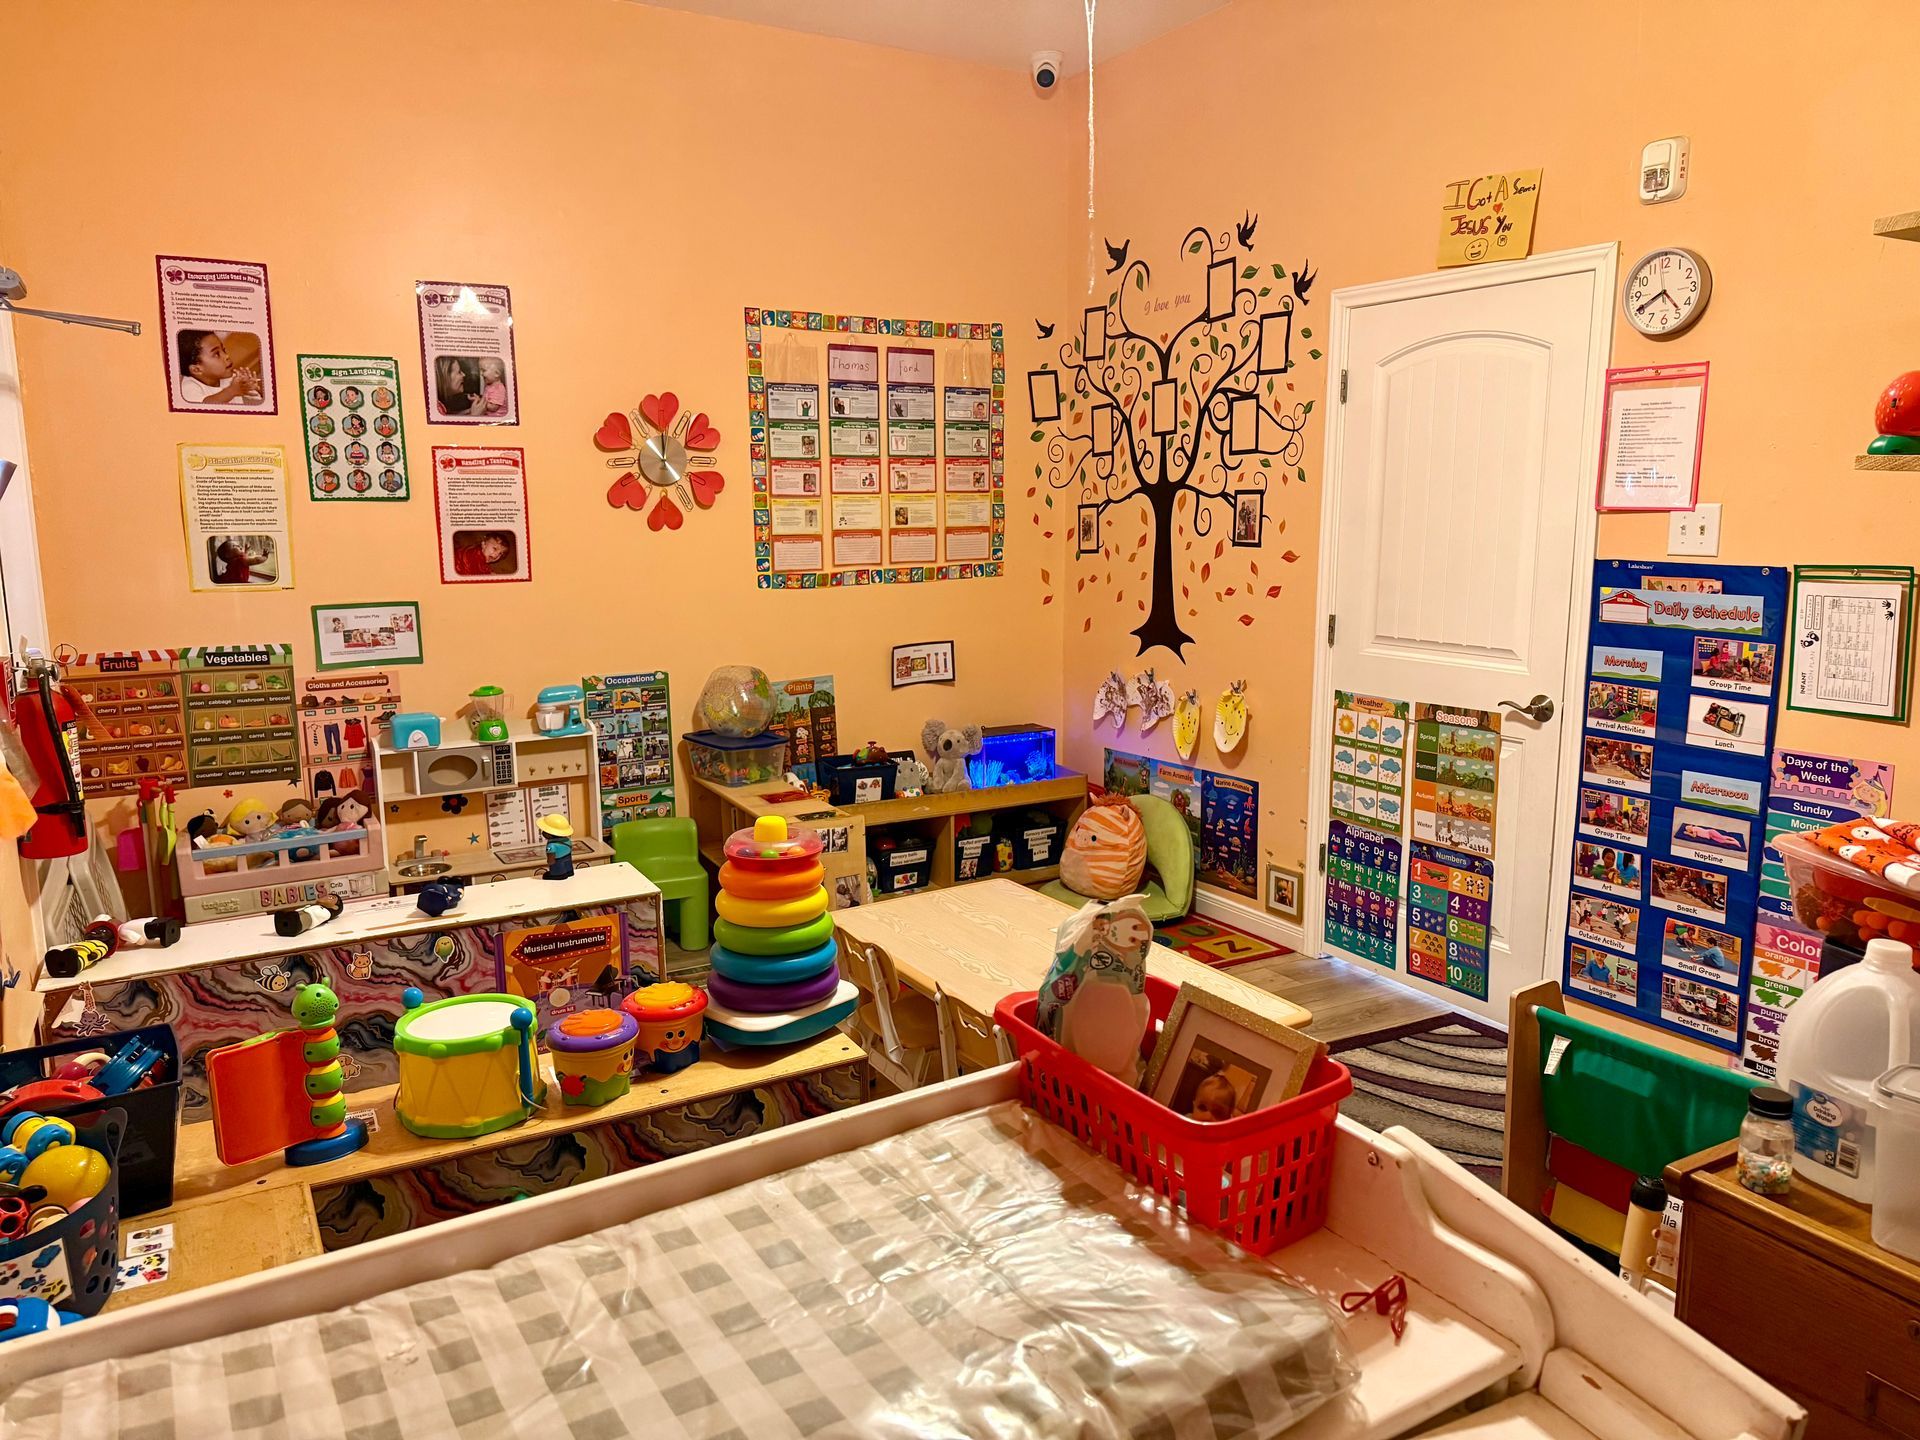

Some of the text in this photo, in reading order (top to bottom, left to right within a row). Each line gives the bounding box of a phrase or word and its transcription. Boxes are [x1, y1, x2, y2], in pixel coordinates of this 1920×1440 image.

[1443, 175, 1509, 210] I Got A
[1450, 214, 1513, 236] Jesus You
[1649, 263, 1656, 276] 11
[1661, 257, 1671, 269] 12
[1638, 267, 1693, 288] 10 2
[1634, 280, 1697, 302] 9 3
[1154, 297, 1169, 312] love
[1174, 294, 1191, 308] you
[1683, 296, 1691, 306] 4
[1648, 308, 1681, 325] 7 6 5
[832, 357, 870, 372] Thomas
[331, 369, 348, 377] Sign
[1654, 600, 1760, 623] Daily Schedule
[102, 659, 137, 670] Fruits
[205, 653, 268, 665] Vegetables
[1604, 655, 1648, 673] Morning
[331, 680, 345, 688] and
[345, 678, 387, 687] Accessories
[606, 675, 655, 686] Occupations
[788, 682, 813, 692] Plants
[1709, 679, 1751, 691] Group Time
[208, 698, 232, 706] cabbage
[1356, 697, 1383, 709] Weather
[97, 706, 117, 715] cherry
[124, 705, 142, 713] peach
[1436, 710, 1479, 728] Seasons
[1595, 720, 1646, 734] Arrival Activities
[155, 740, 182, 748] pineapple
[1420, 733, 1437, 743] Spring
[1714, 739, 1735, 749] Lunch
[1416, 762, 1437, 771] Summer
[1786, 756, 1849, 774] Days of the
[195, 771, 223, 779] cucumber
[1159, 769, 1193, 782] Farm Animals
[1607, 777, 1626, 786] Snack
[1801, 771, 1831, 784] Week
[1231, 781, 1251, 791] Animals
[1690, 781, 1749, 800] Afternoon
[618, 794, 648, 805] Sports
[1415, 791, 1435, 800] Autumn
[1792, 802, 1833, 818] Sunday
[1416, 820, 1433, 829] Winter
[1345, 825, 1385, 845] Alphabet
[1594, 828, 1632, 842] Group Time
[1330, 834, 1398, 861] Aa Bb Cc Dd Ee
[1435, 851, 1467, 866] Numbers
[1694, 851, 1724, 864] Naptime
[1329, 855, 1396, 885] Ff Gg Hh Ii Jj Kk
[1414, 862, 1462, 886] 1 2
[1328, 877, 1395, 909] Ll Mm Nn Oo Pp
[1601, 883, 1612, 891] Art
[260, 881, 328, 908] BABIES
[1412, 885, 1460, 910] 3 4
[1327, 898, 1394, 930] Qq Rr Ss Tt Uu
[1677, 904, 1698, 915] Snack
[1412, 907, 1459, 933] 5 6
[1327, 919, 1393, 953] Vv Ww Xx Yy Zz
[1412, 929, 1458, 957] 7 8
[1578, 930, 1625, 950] Outside Activity
[523, 934, 605, 954] Musical Instruments
[1764, 951, 1795, 964] orange
[1412, 952, 1463, 981] 9 10
[1678, 961, 1721, 980] Small Group
[1588, 985, 1617, 999] Language
[1764, 980, 1790, 992] green
[1677, 1016, 1719, 1035] Center Time
[1758, 1034, 1780, 1047] brow
